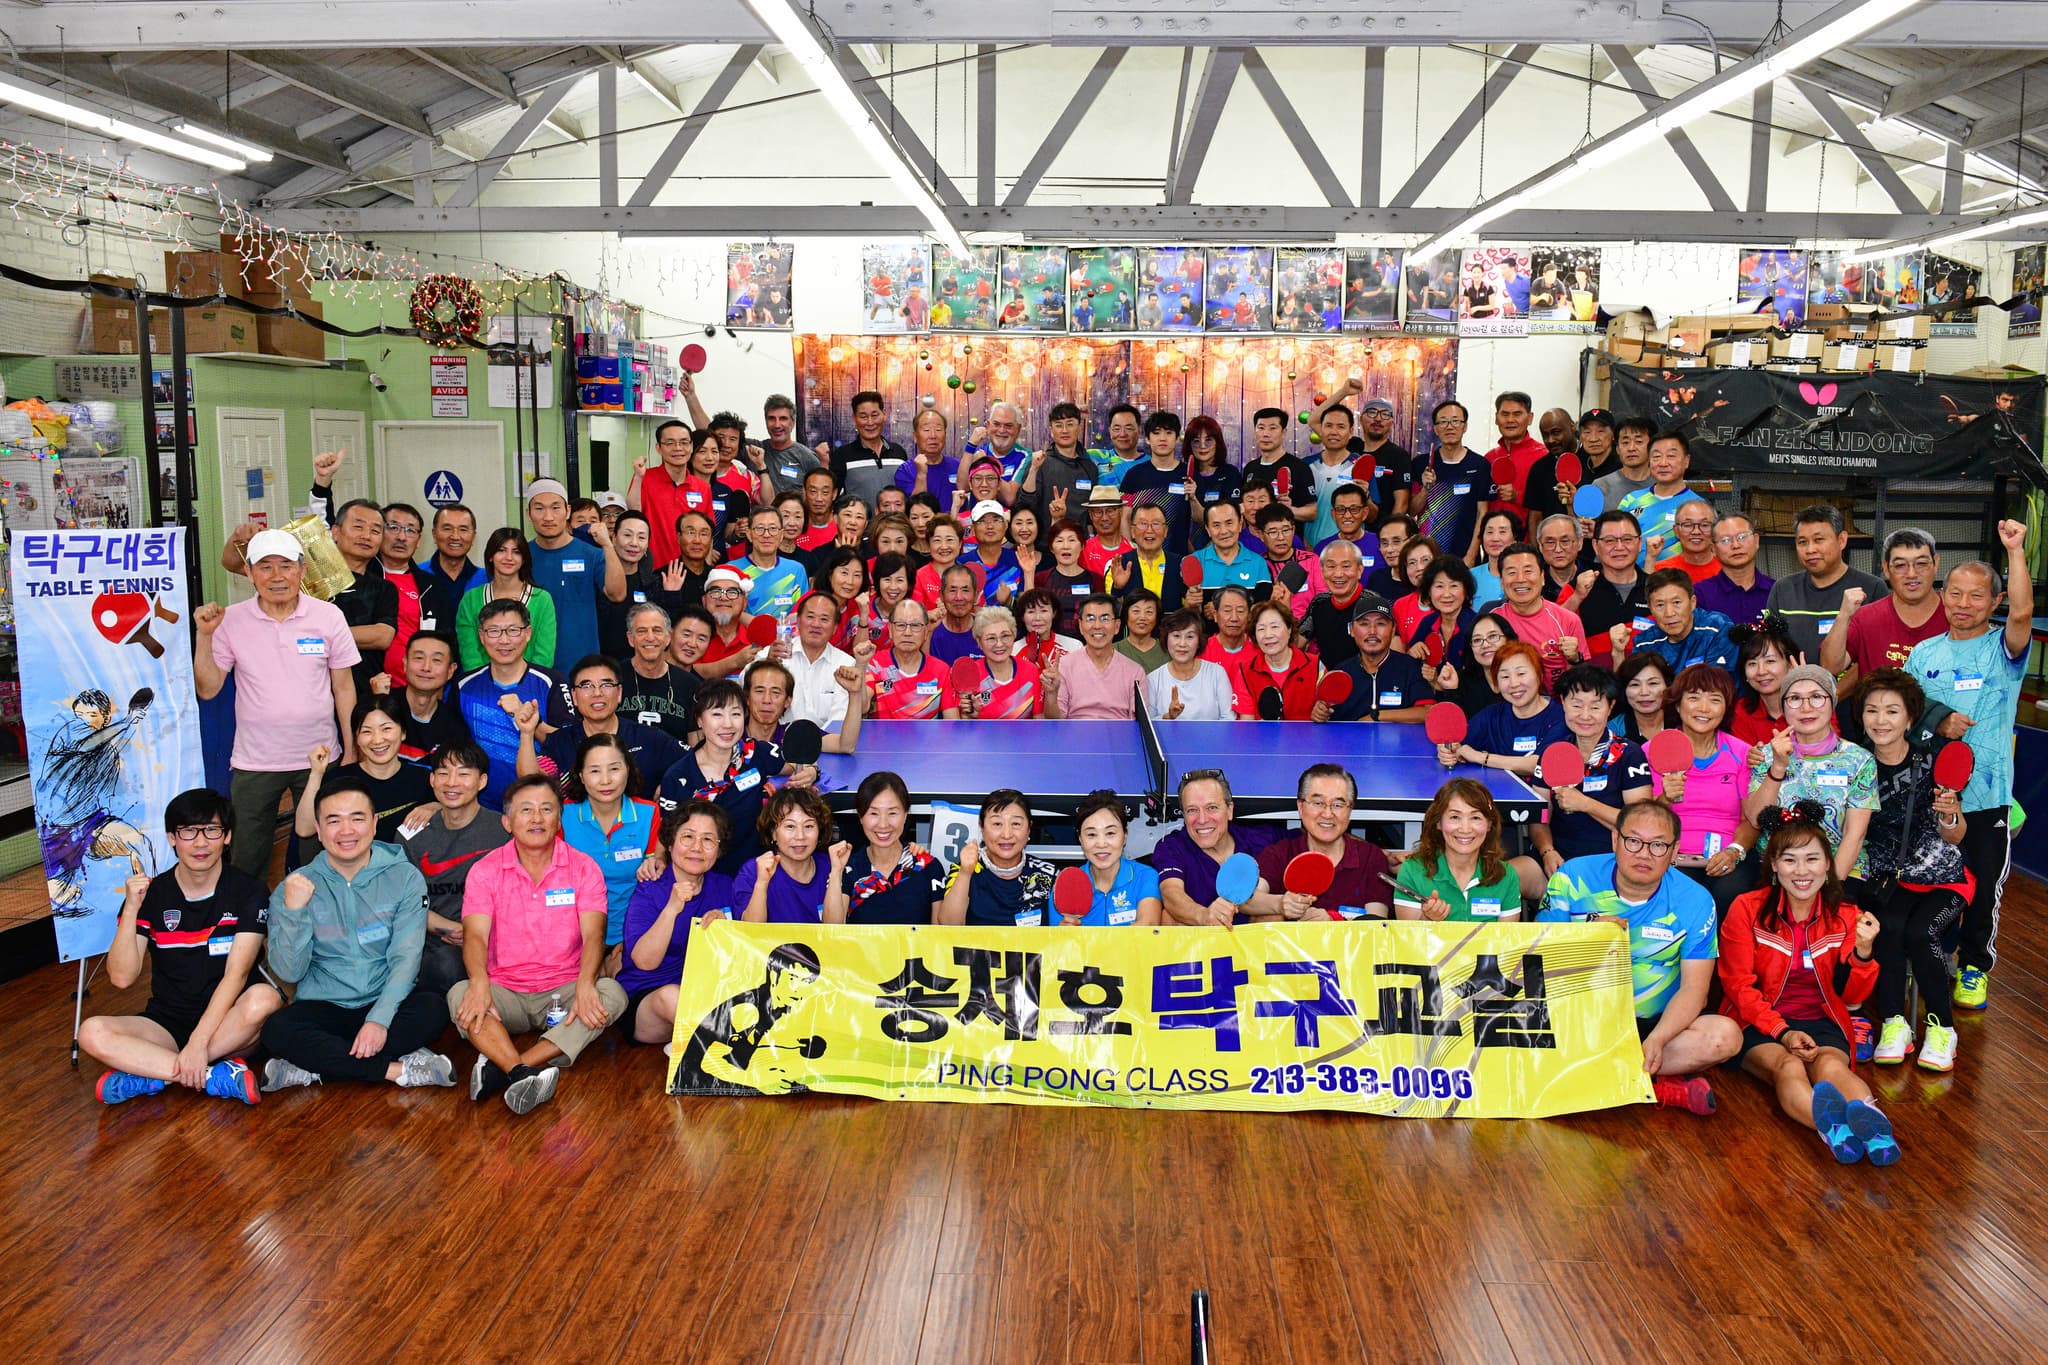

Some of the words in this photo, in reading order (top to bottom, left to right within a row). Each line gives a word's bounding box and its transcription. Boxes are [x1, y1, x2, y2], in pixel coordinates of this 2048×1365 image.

[435, 387, 465, 395] AVISO
[1817, 406, 1854, 417] BUTTERY
[1717, 426, 1771, 448] FAN
[1775, 428, 1934, 455] ZHENDONG
[1769, 453, 1790, 465] MEN'S
[1791, 454, 1817, 466] SINGLES
[1818, 456, 1842, 467] WORLD
[1842, 457, 1877, 468] CHAMPION
[23, 532, 177, 575] 탁구대회
[26, 580, 94, 597] TABLE
[100, 577, 175, 594] TENNIS
[559, 683, 576, 717] NEXY
[617, 695, 646, 712] ASS
[649, 695, 686, 719] TECH
[944, 822, 970, 863] 3
[875, 946, 1133, 1044] 송제호
[937, 1062, 1014, 1088] PING
[1023, 1065, 1117, 1092] PONG
[1126, 1067, 1229, 1093] CLASS
[1250, 1065, 1474, 1100] 213-383-0096
